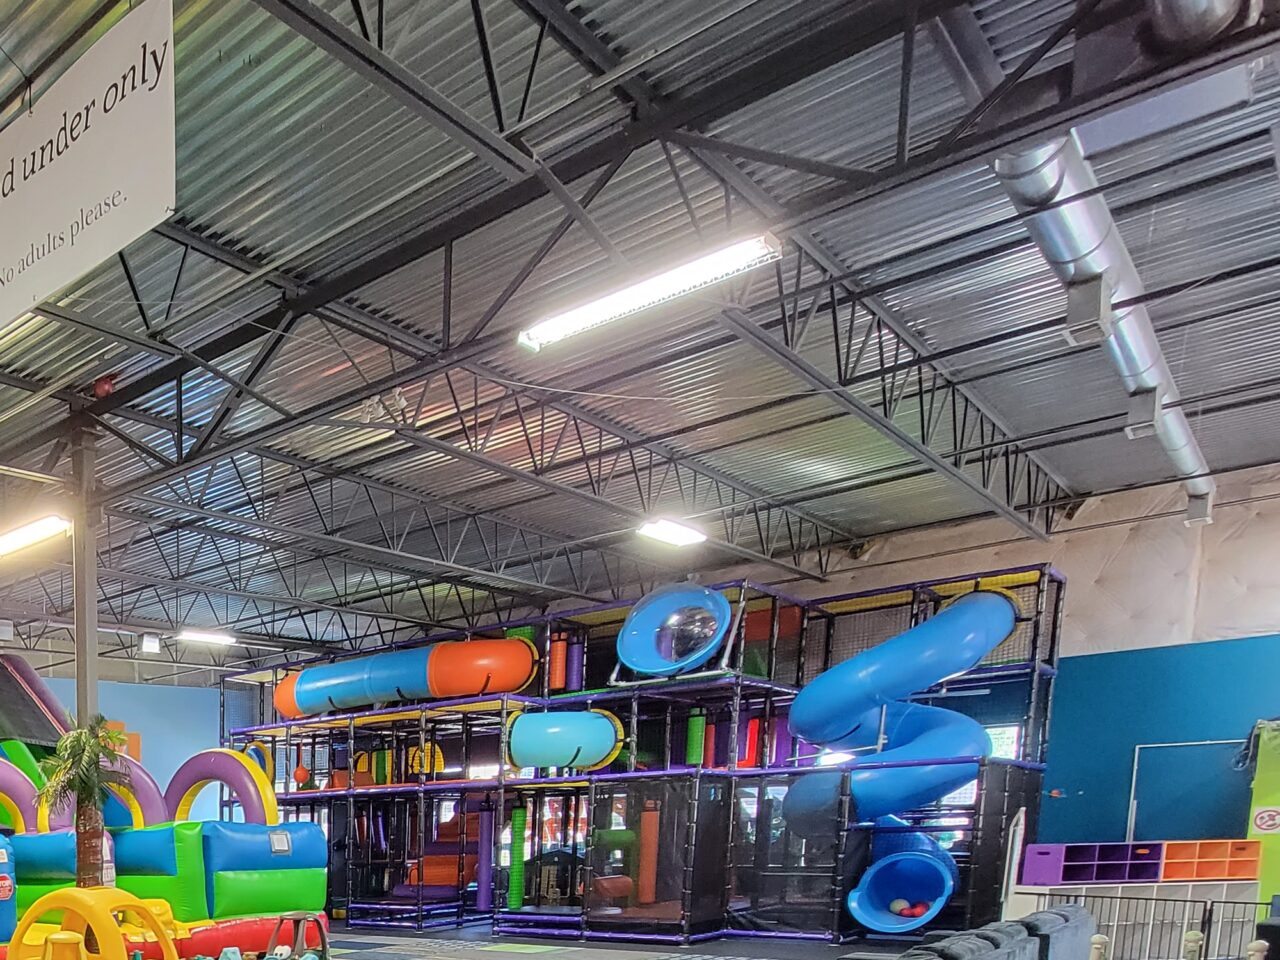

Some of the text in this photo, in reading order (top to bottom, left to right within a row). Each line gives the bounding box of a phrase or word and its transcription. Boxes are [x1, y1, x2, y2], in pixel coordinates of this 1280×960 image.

[22, 98, 96, 181] under
[103, 39, 169, 114] only
[18, 231, 65, 274] adults
[70, 190, 127, 246] please.
